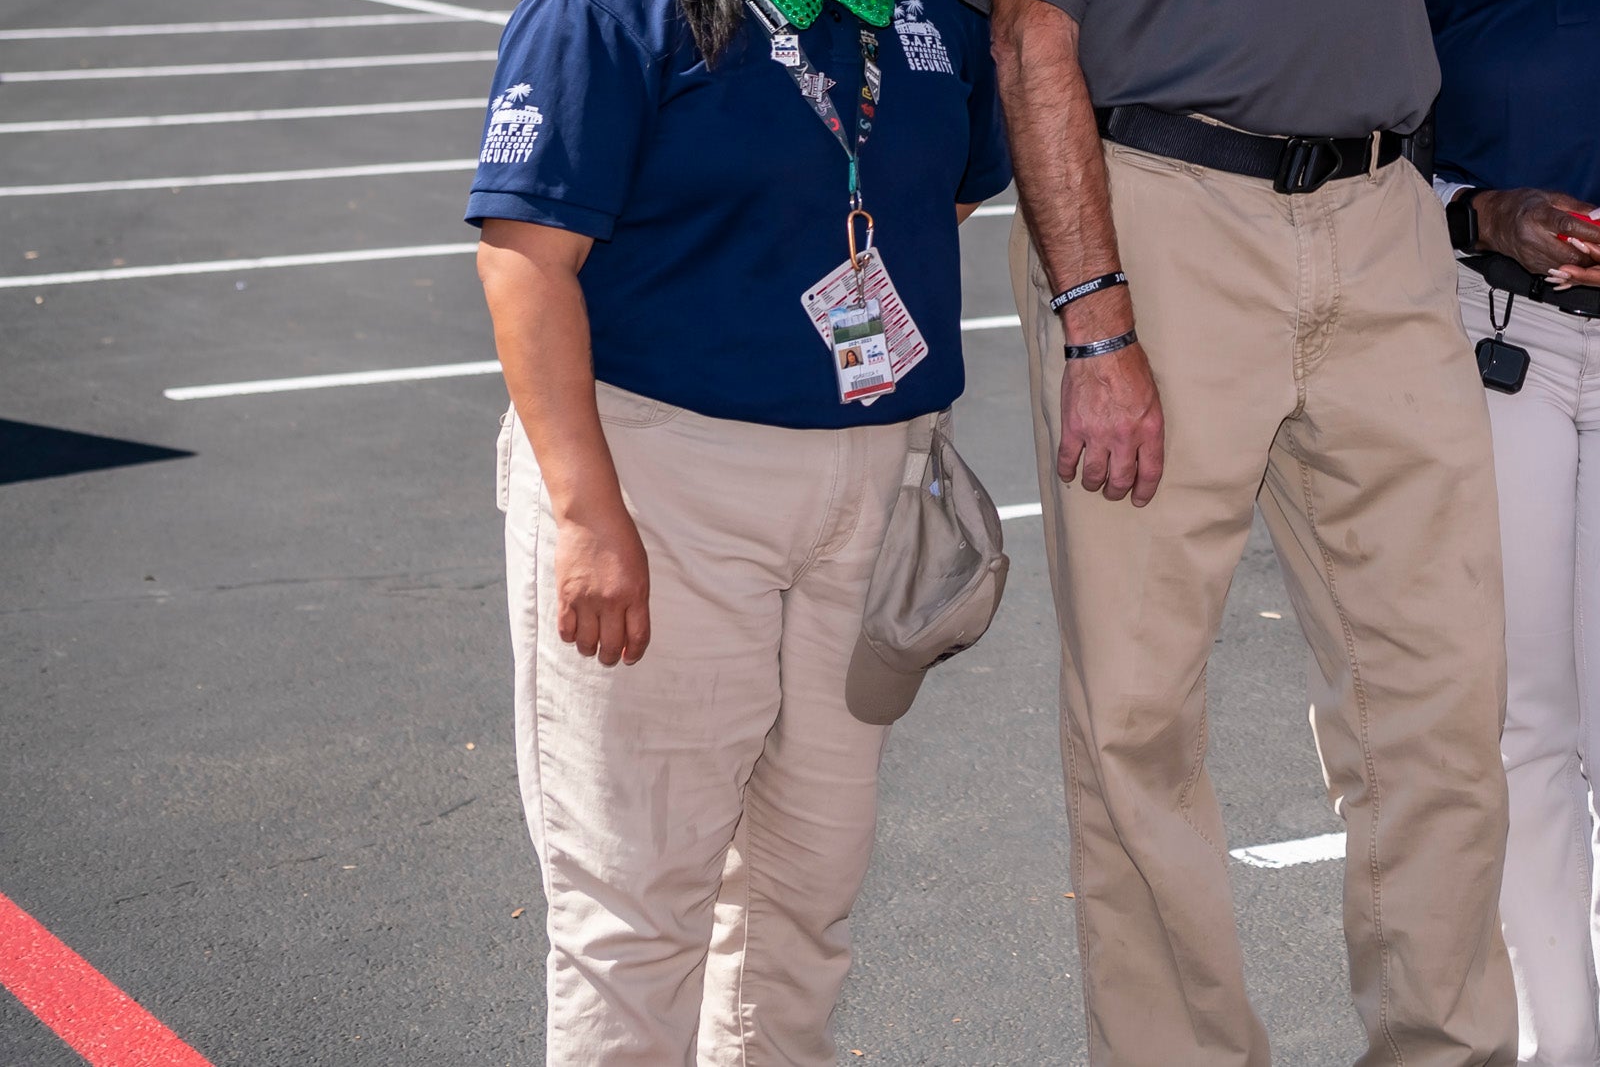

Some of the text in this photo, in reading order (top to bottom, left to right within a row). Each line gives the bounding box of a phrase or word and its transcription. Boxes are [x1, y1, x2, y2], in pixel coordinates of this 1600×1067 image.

[899, 35, 947, 51] S.A.F.E.
[902, 46, 948, 57] MANAGEMENT
[905, 51, 950, 63] OF ARIZONA
[907, 57, 954, 75] SECURITY
[1115, 272, 1126, 283] JO
[1055, 294, 1068, 307] THE
